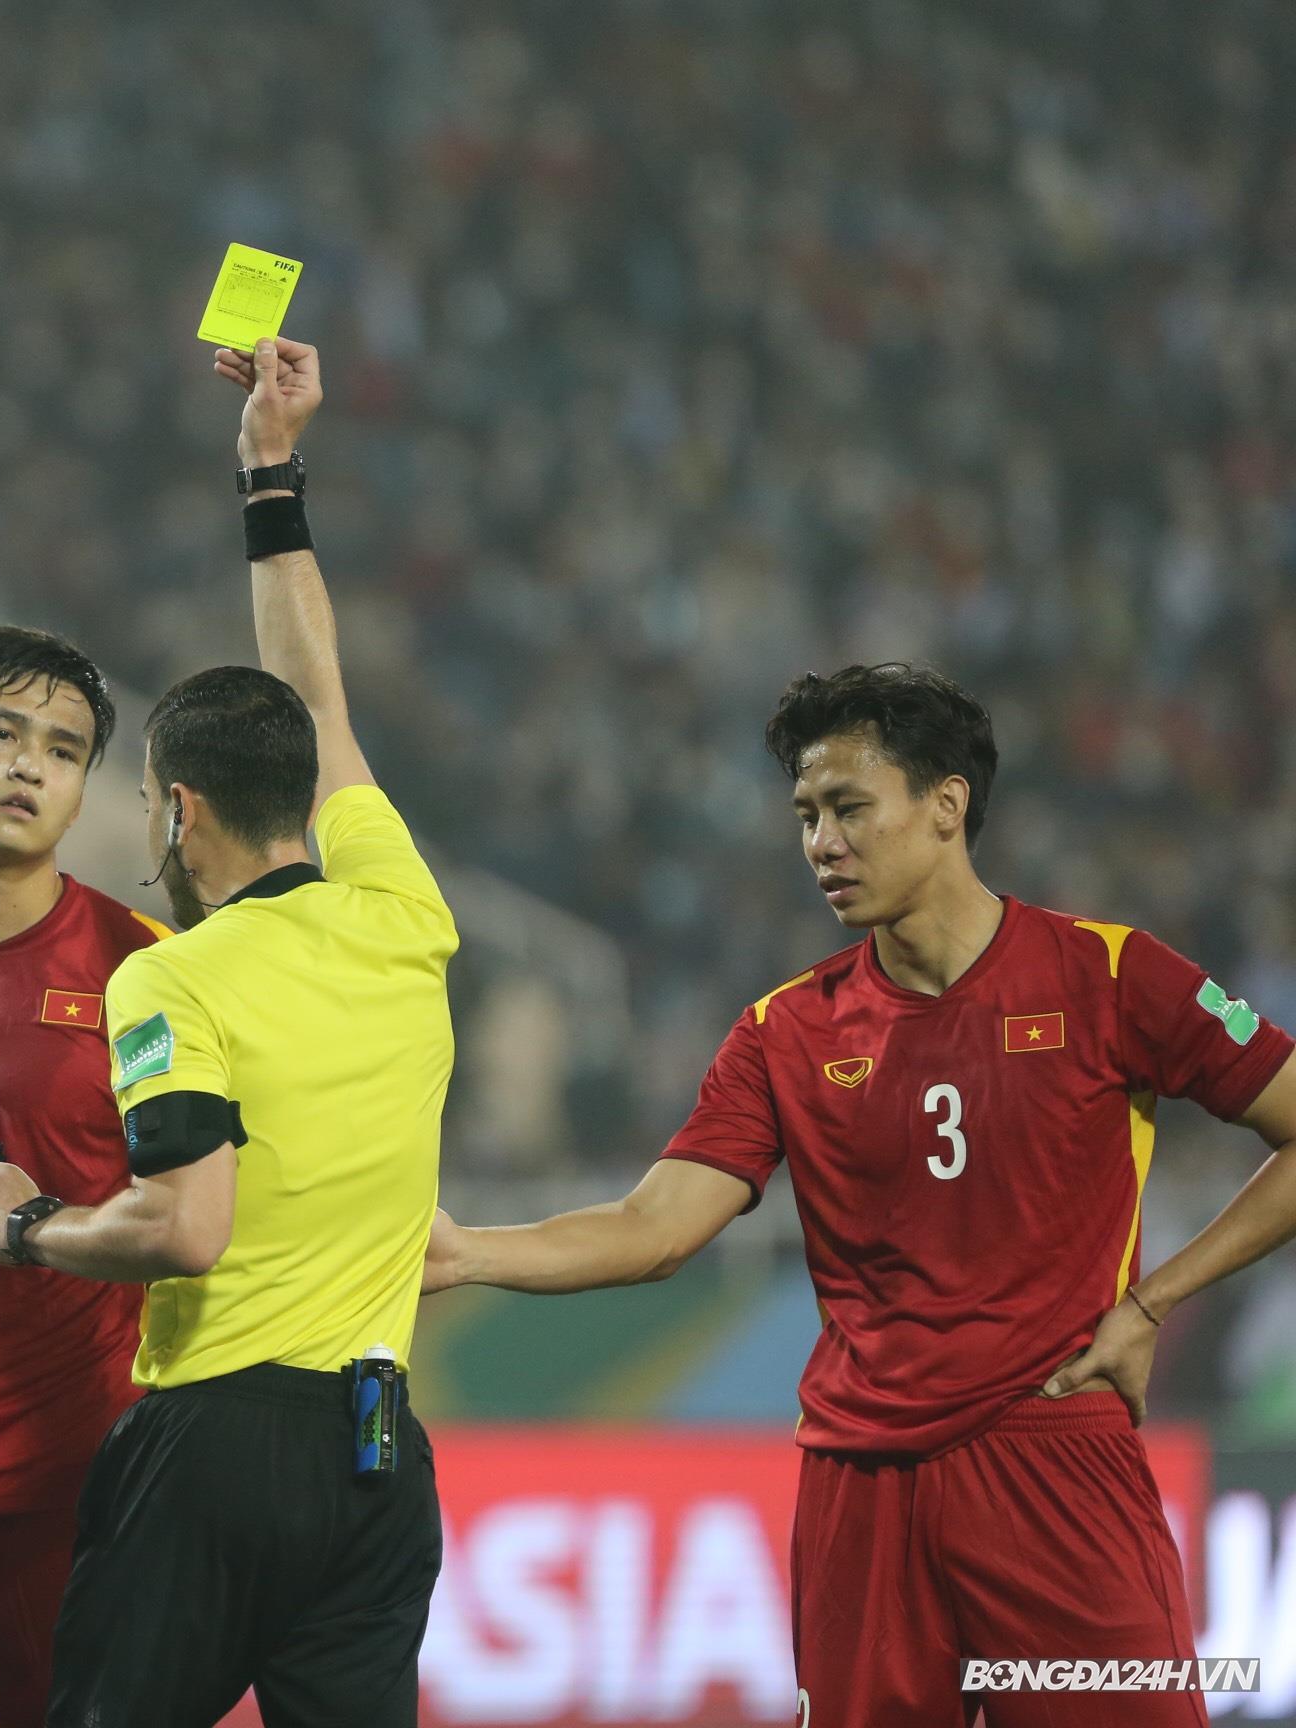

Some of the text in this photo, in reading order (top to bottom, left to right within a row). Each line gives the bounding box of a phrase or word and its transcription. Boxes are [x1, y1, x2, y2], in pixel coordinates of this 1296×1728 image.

[274, 260, 295, 273] FIFA
[125, 1033, 168, 1064] LIVING
[924, 1083, 968, 1180] 3
